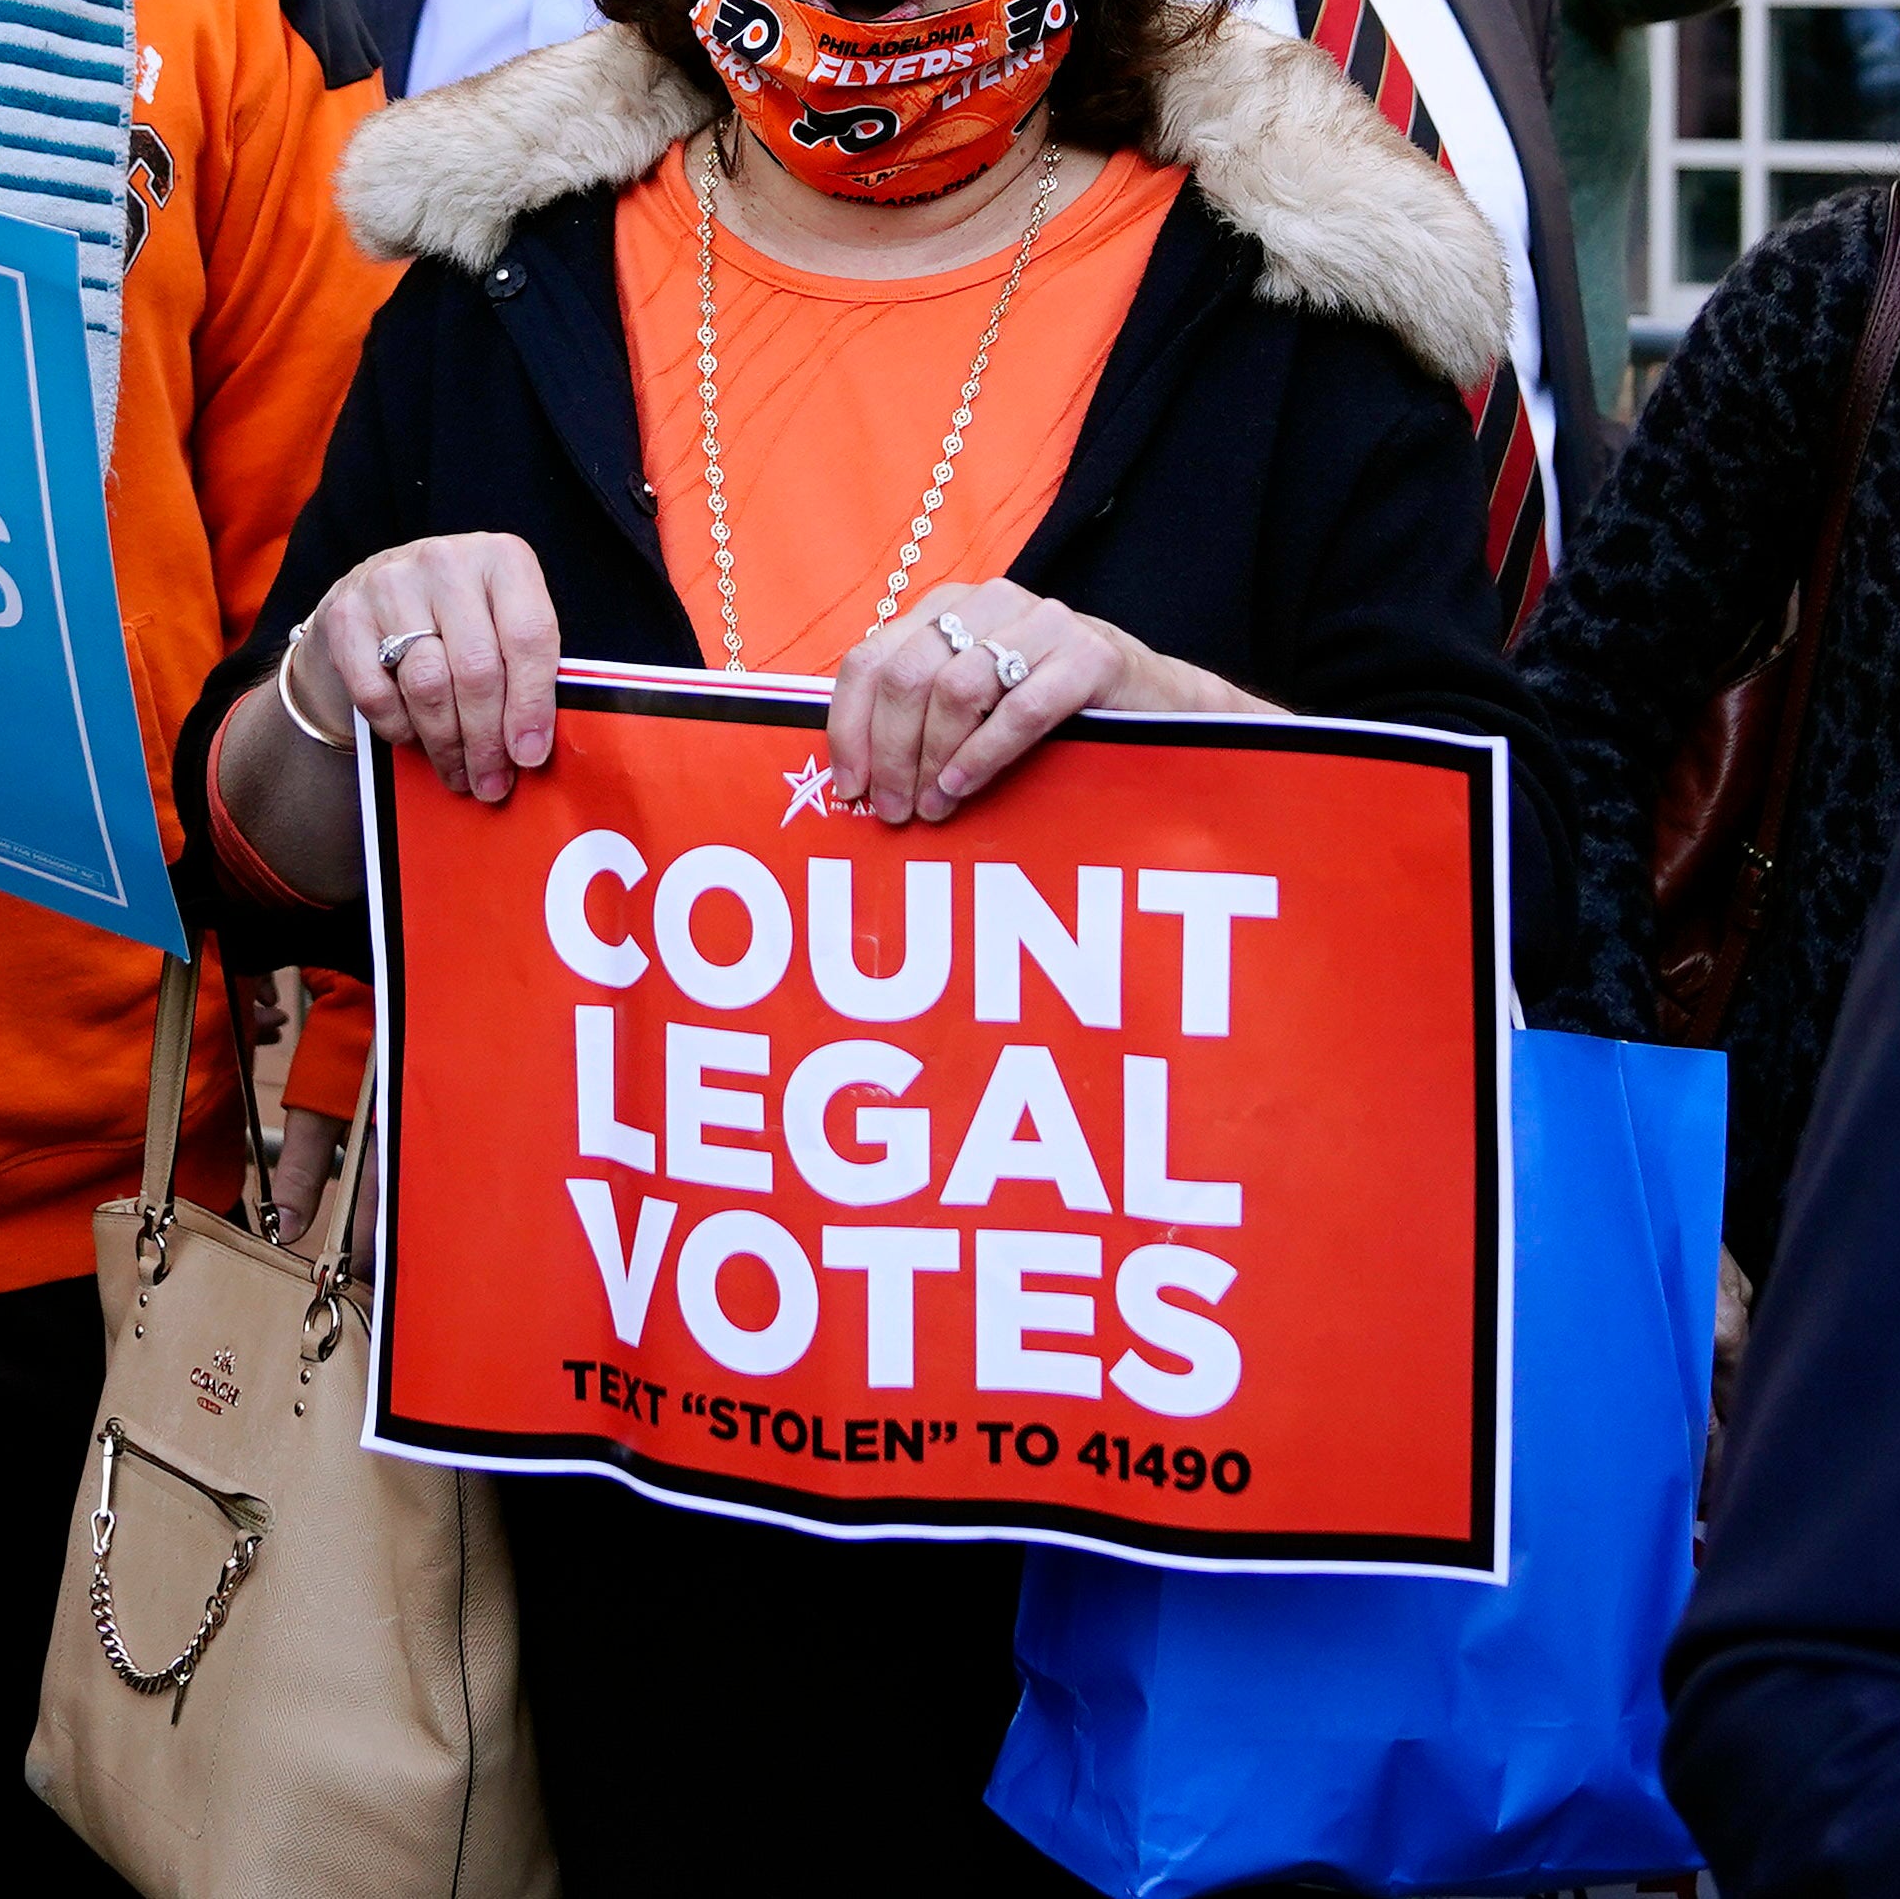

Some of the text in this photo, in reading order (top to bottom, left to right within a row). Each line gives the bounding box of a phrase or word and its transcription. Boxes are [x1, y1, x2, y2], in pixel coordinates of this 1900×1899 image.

[818, 22, 975, 57] PHILADELPHIA
[941, 41, 1044, 111] LYERS
[544, 828, 1279, 1036] COUNT
[574, 1003, 1243, 1227] LEGAL
[565, 1177, 1243, 1418] VOTES
[190, 1367, 242, 1407] COACH
[562, 1360, 667, 1427] TEXT
[975, 1420, 1059, 1467] TO
[1076, 1431, 1251, 1495] 41490
